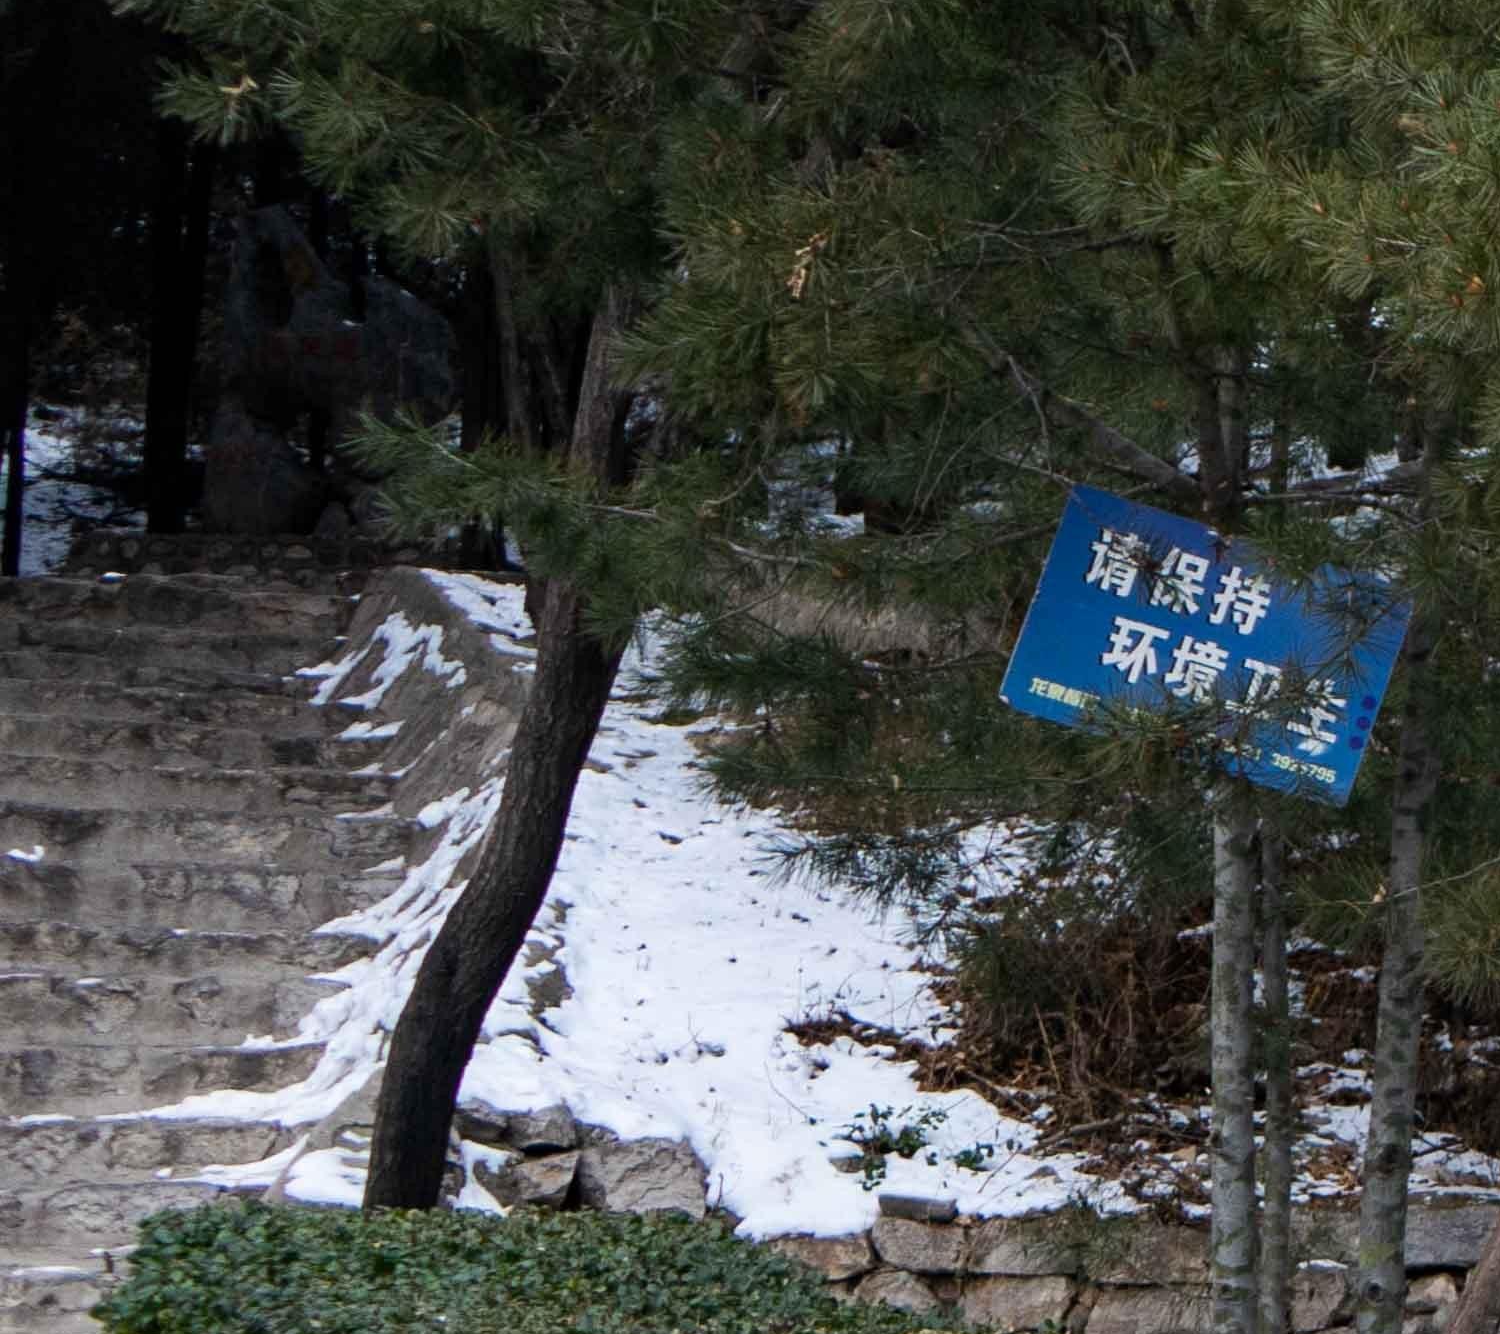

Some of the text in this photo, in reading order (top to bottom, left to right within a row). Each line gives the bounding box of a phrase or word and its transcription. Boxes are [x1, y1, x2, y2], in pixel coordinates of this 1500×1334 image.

[1086, 528, 1271, 635] 请保持
[1101, 617, 1346, 754] 环境卫生
